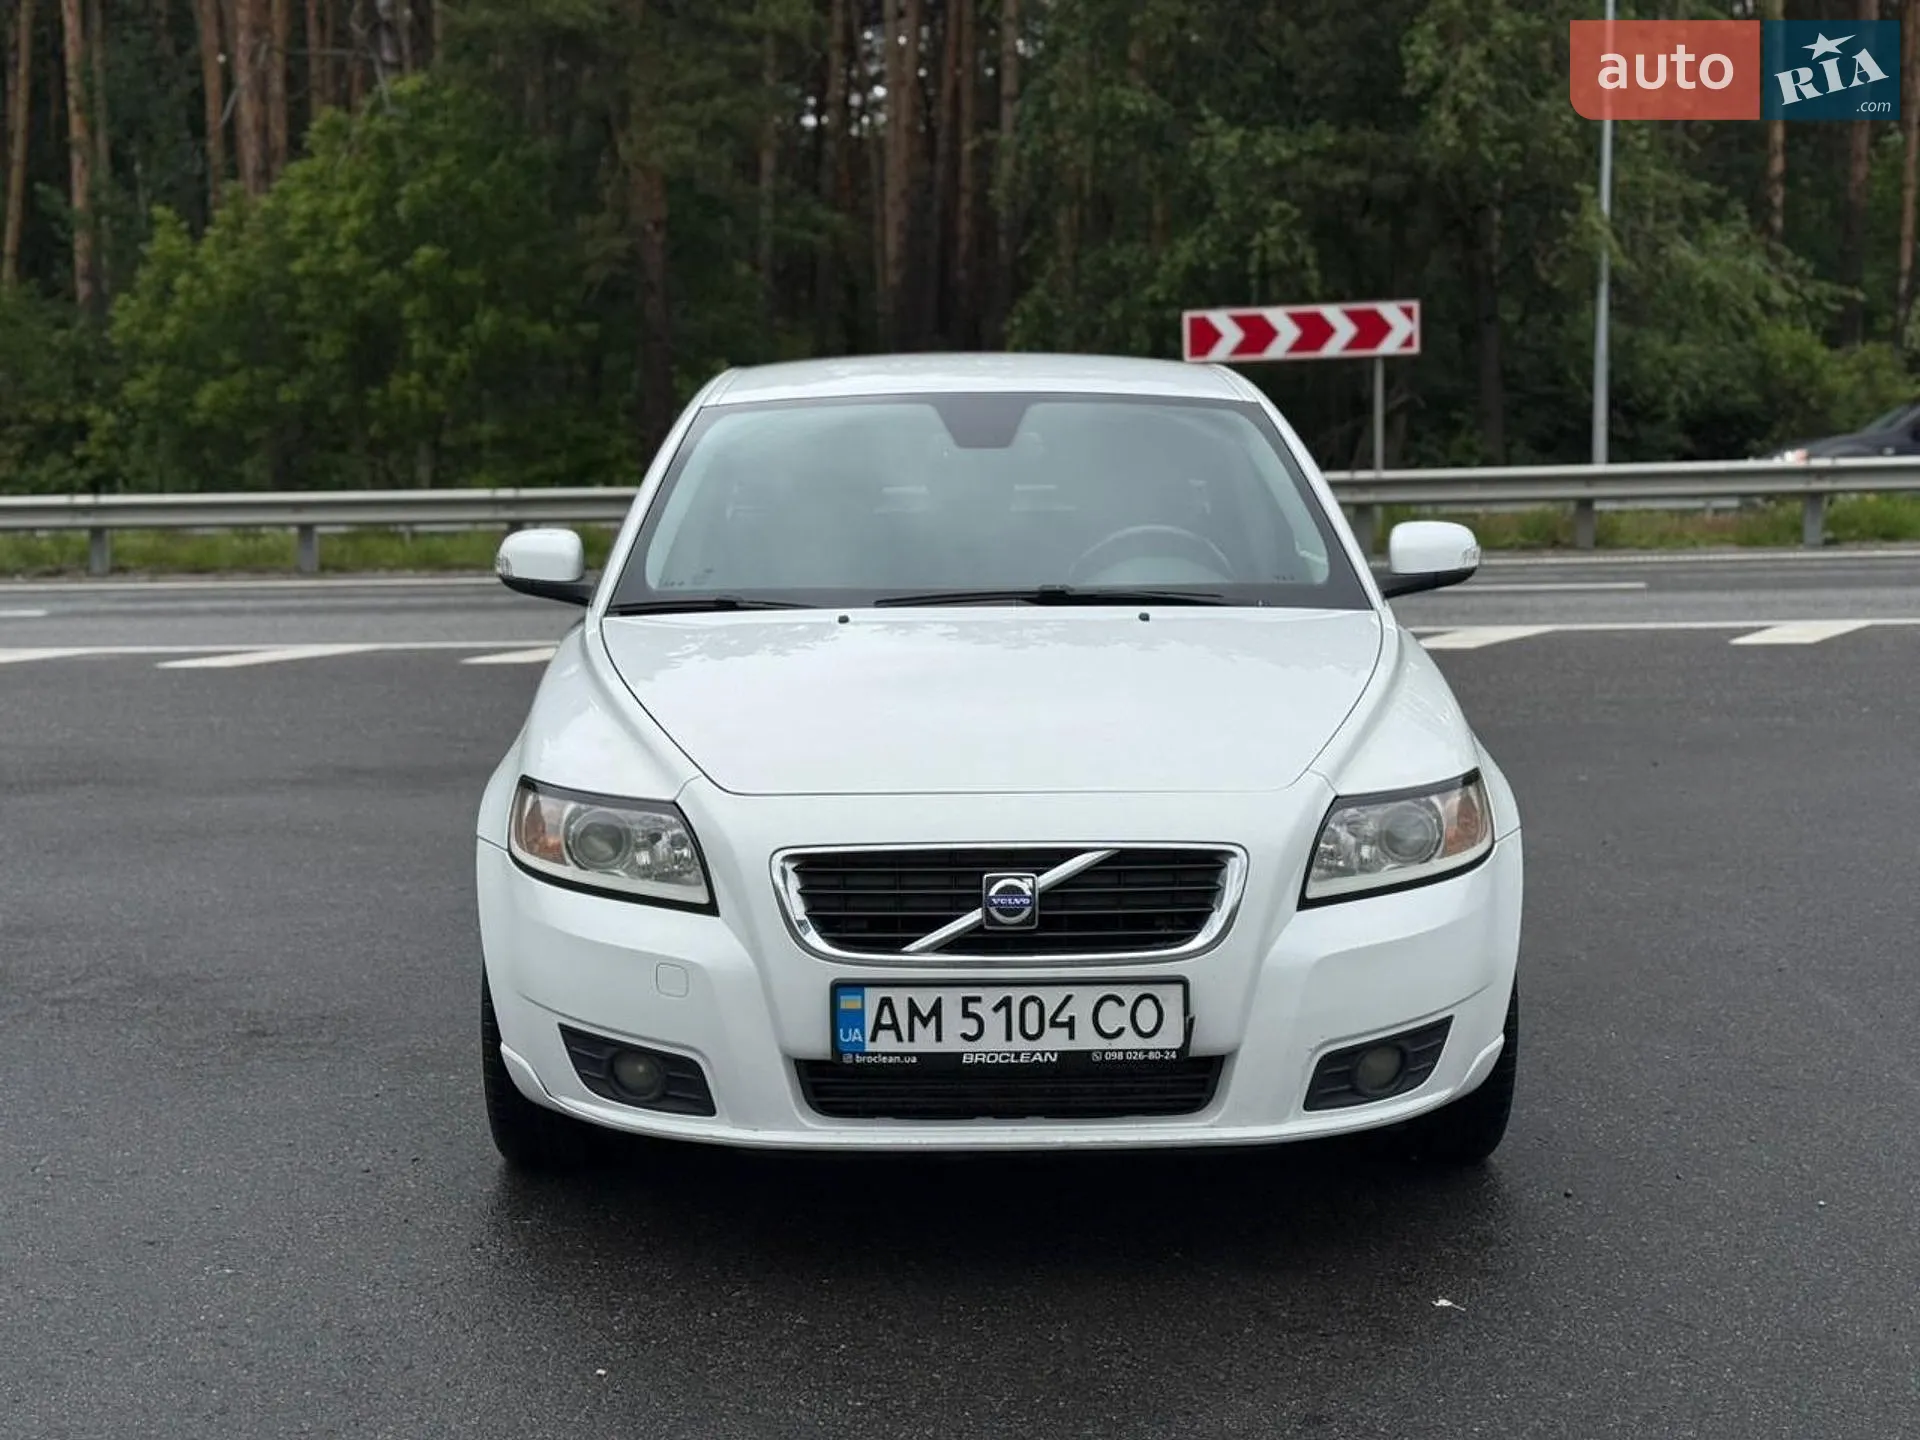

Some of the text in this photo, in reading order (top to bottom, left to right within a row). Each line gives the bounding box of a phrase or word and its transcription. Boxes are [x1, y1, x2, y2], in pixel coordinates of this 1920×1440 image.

[869, 993, 1164, 1042] AM 5104 CO
[839, 1028, 863, 1042] UA
[855, 1053, 917, 1064] broclean.ua
[962, 1052, 1058, 1064] BROCLEAN
[1104, 1051, 1123, 1061] 098
